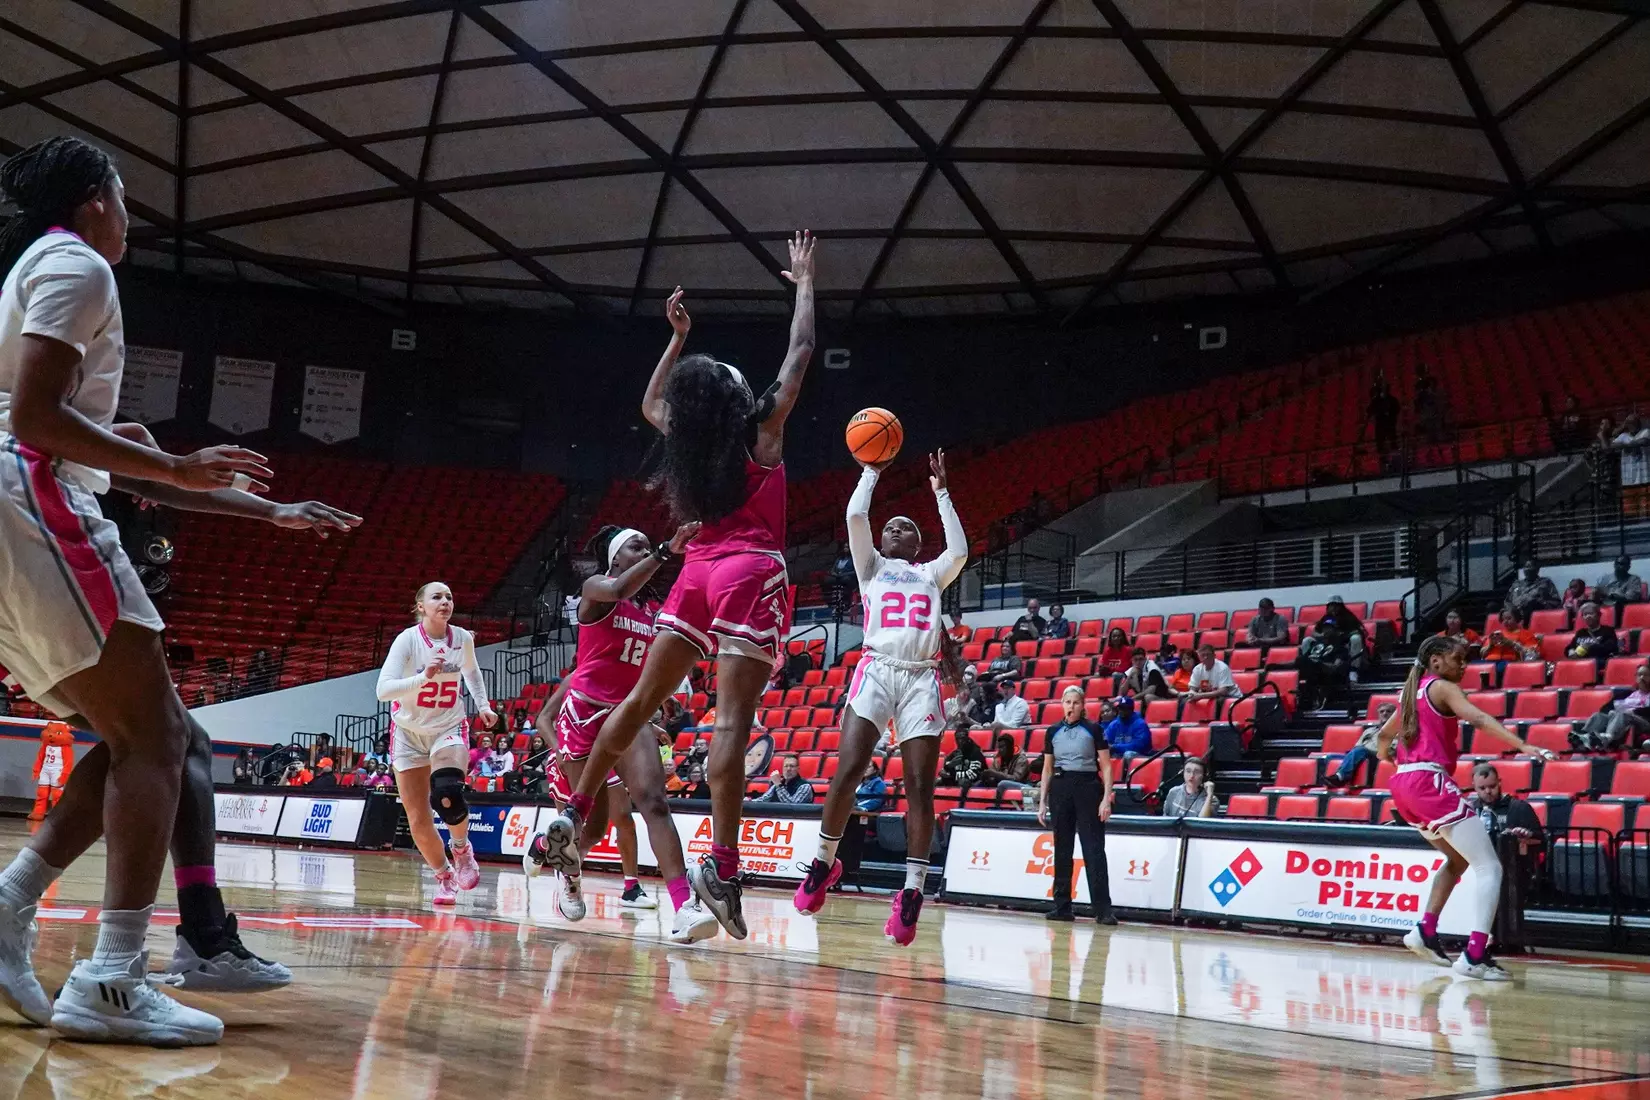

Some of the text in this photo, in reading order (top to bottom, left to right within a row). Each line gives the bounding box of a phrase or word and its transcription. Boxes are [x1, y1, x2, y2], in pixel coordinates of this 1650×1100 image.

[391, 329, 416, 351] B
[1200, 326, 1227, 350] D
[824, 348, 851, 369] C
[881, 591, 931, 631] 22
[612, 615, 631, 631] SAM
[619, 637, 647, 667] 12
[416, 681, 458, 709] 25
[311, 803, 332, 819] BUD
[303, 818, 333, 834] LIGHT
[470, 822, 495, 833] Athletics
[772, 847, 792, 857] INC.
[1285, 849, 1461, 885] Domino'
[1318, 880, 1420, 912] Pizza
[1296, 907, 1324, 919] Order
[1325, 910, 1357, 922] Online
